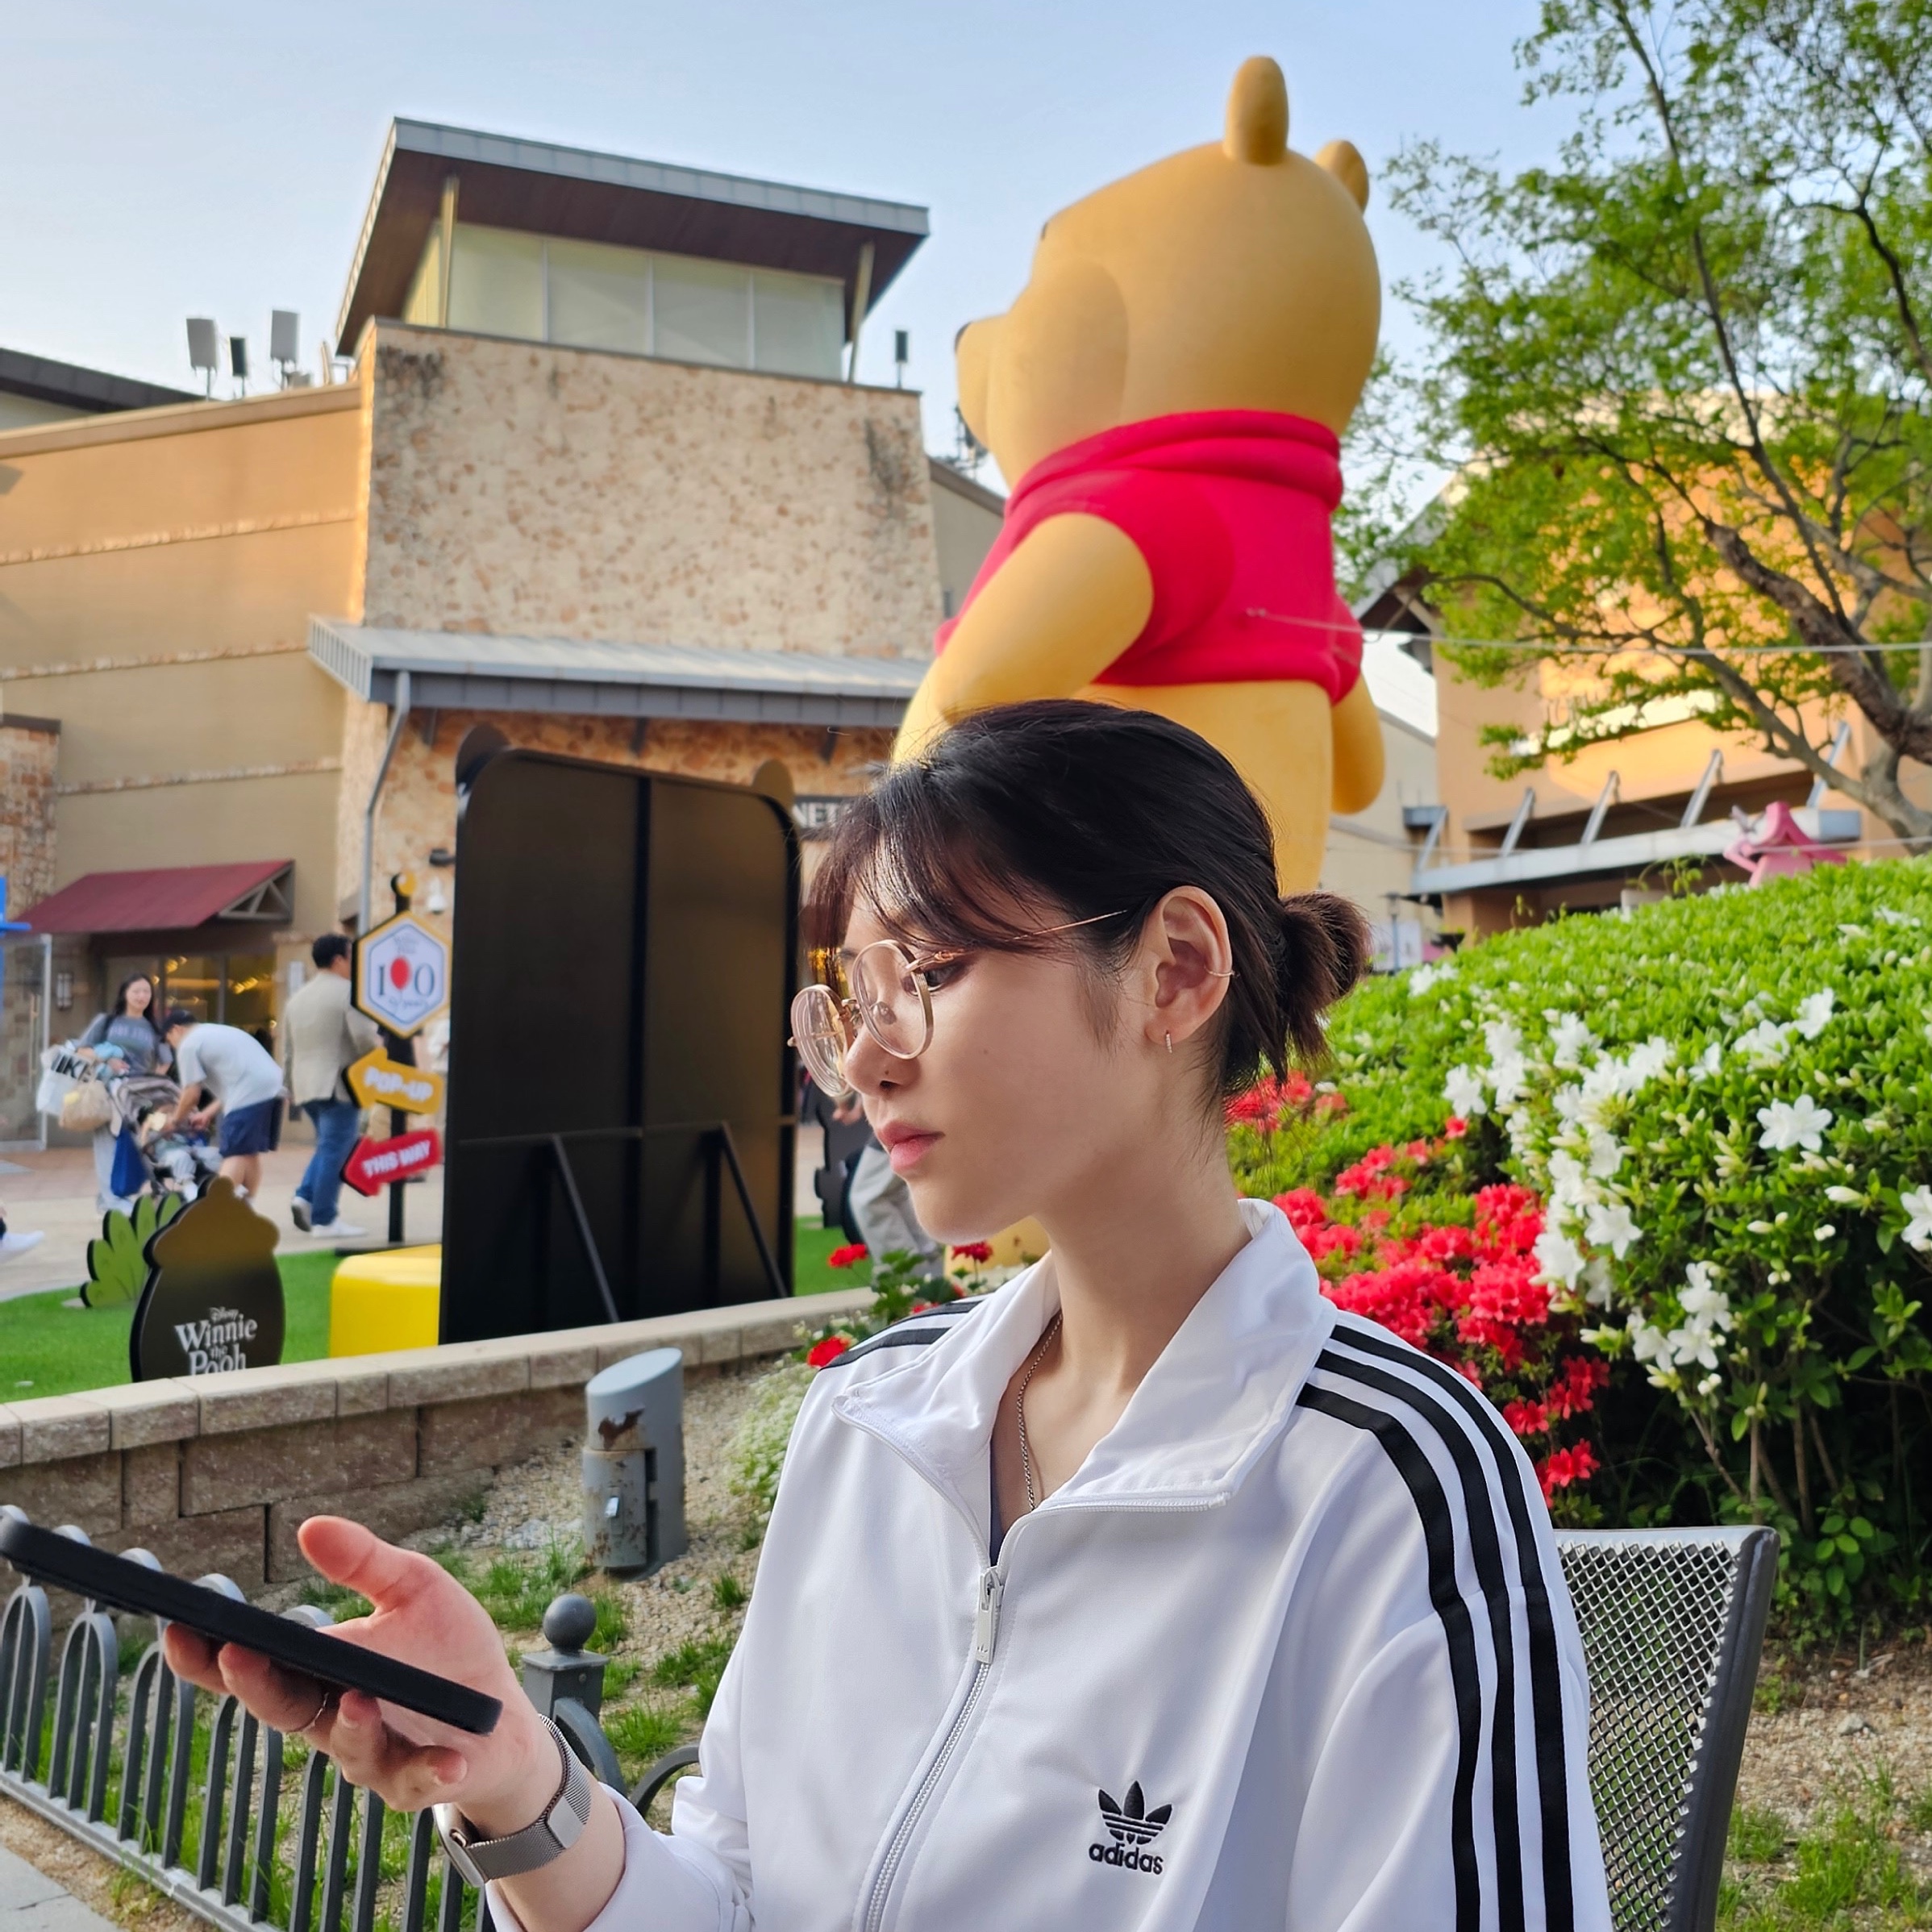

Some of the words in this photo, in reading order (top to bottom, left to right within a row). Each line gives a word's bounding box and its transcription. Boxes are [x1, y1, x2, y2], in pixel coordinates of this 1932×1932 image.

[361, 1151, 399, 1176] THIS
[398, 1139, 431, 1167] WAY
[174, 1314, 258, 1352] Winnie
[189, 1343, 247, 1376] Pooh
[1089, 1842, 1164, 1875] adidas
